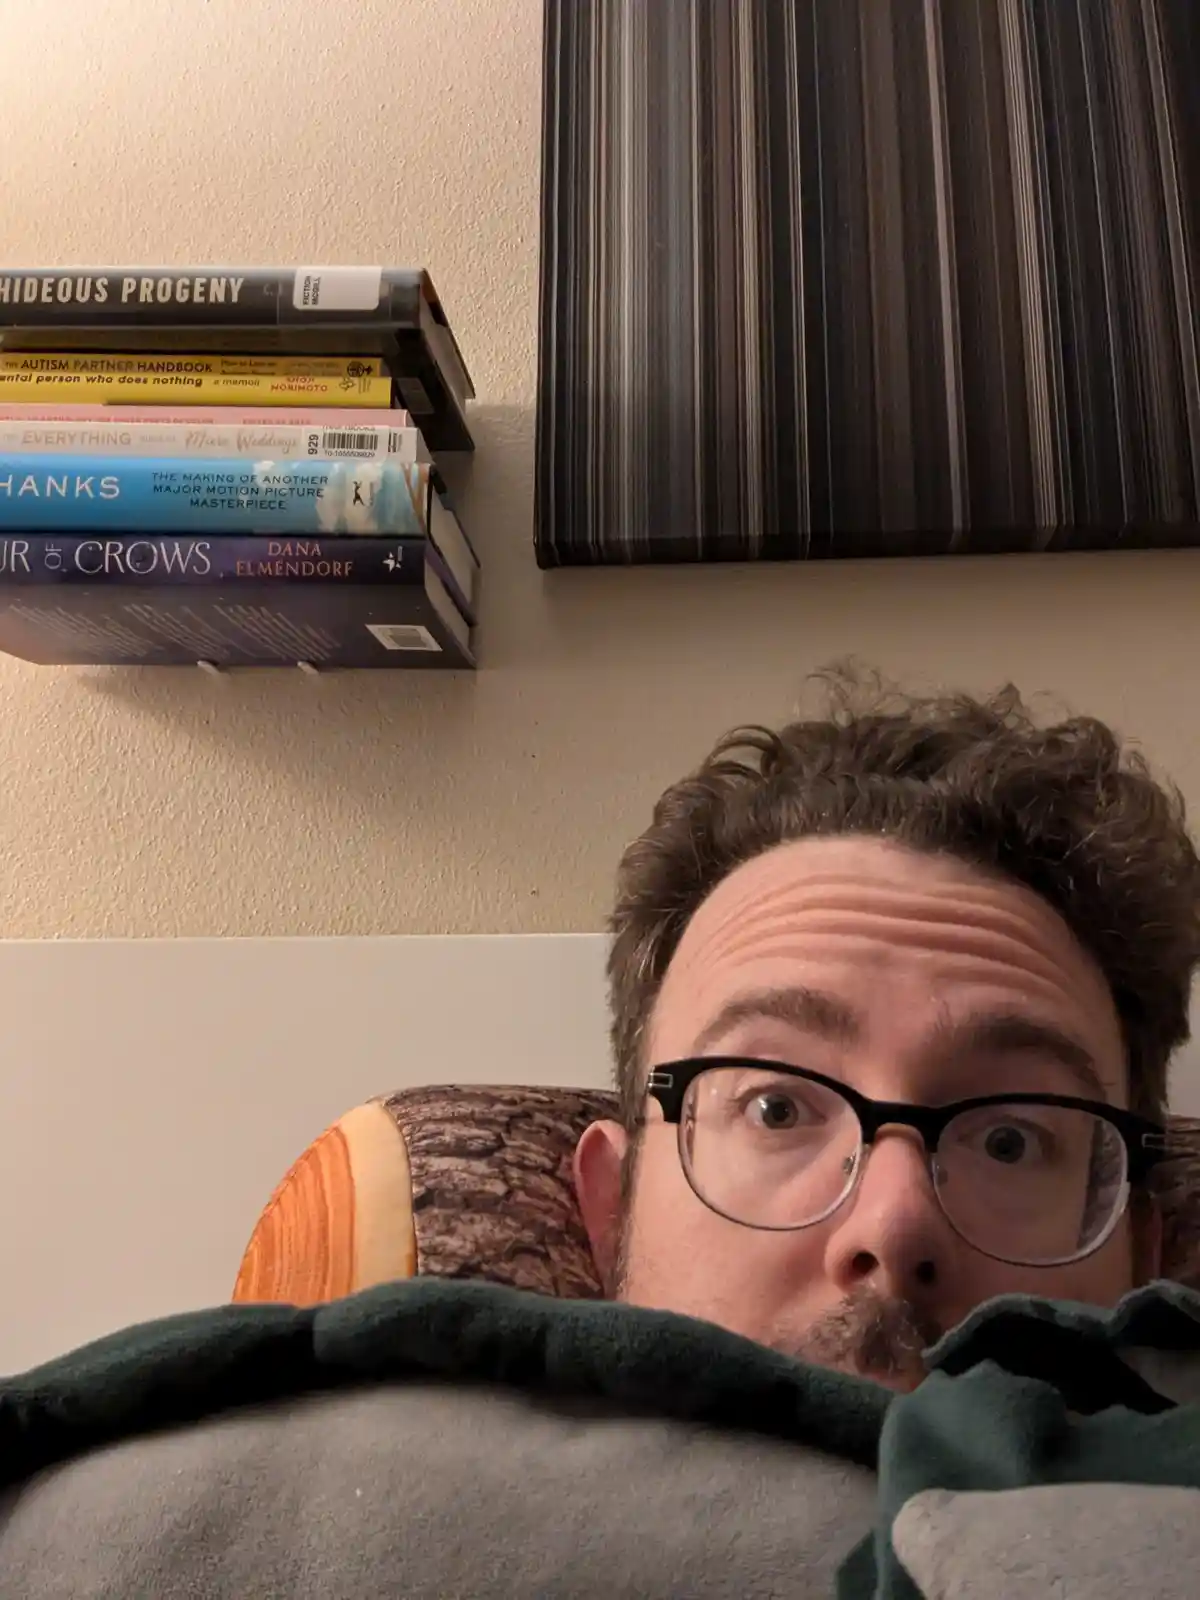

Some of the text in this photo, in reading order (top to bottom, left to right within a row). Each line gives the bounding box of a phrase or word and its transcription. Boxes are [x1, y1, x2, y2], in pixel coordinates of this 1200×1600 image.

[121, 277, 244, 304] PROGENY
[21, 359, 69, 370] AUTISM
[73, 359, 133, 371] PARTNER
[137, 362, 213, 373] HANDBOOK
[36, 375, 81, 385] person
[86, 374, 113, 384] who
[118, 375, 148, 385] does
[152, 376, 203, 387] nothing
[21, 429, 132, 446] EVERYTHING
[307, 434, 320, 455] 929
[152, 472, 329, 486] THE MAKING OF ANOTHER
[153, 485, 326, 498] MAJOR MOTION PICTURE
[190, 498, 288, 511] MASTERPIECE
[267, 541, 322, 557] DANA
[74, 540, 212, 575] CROWS
